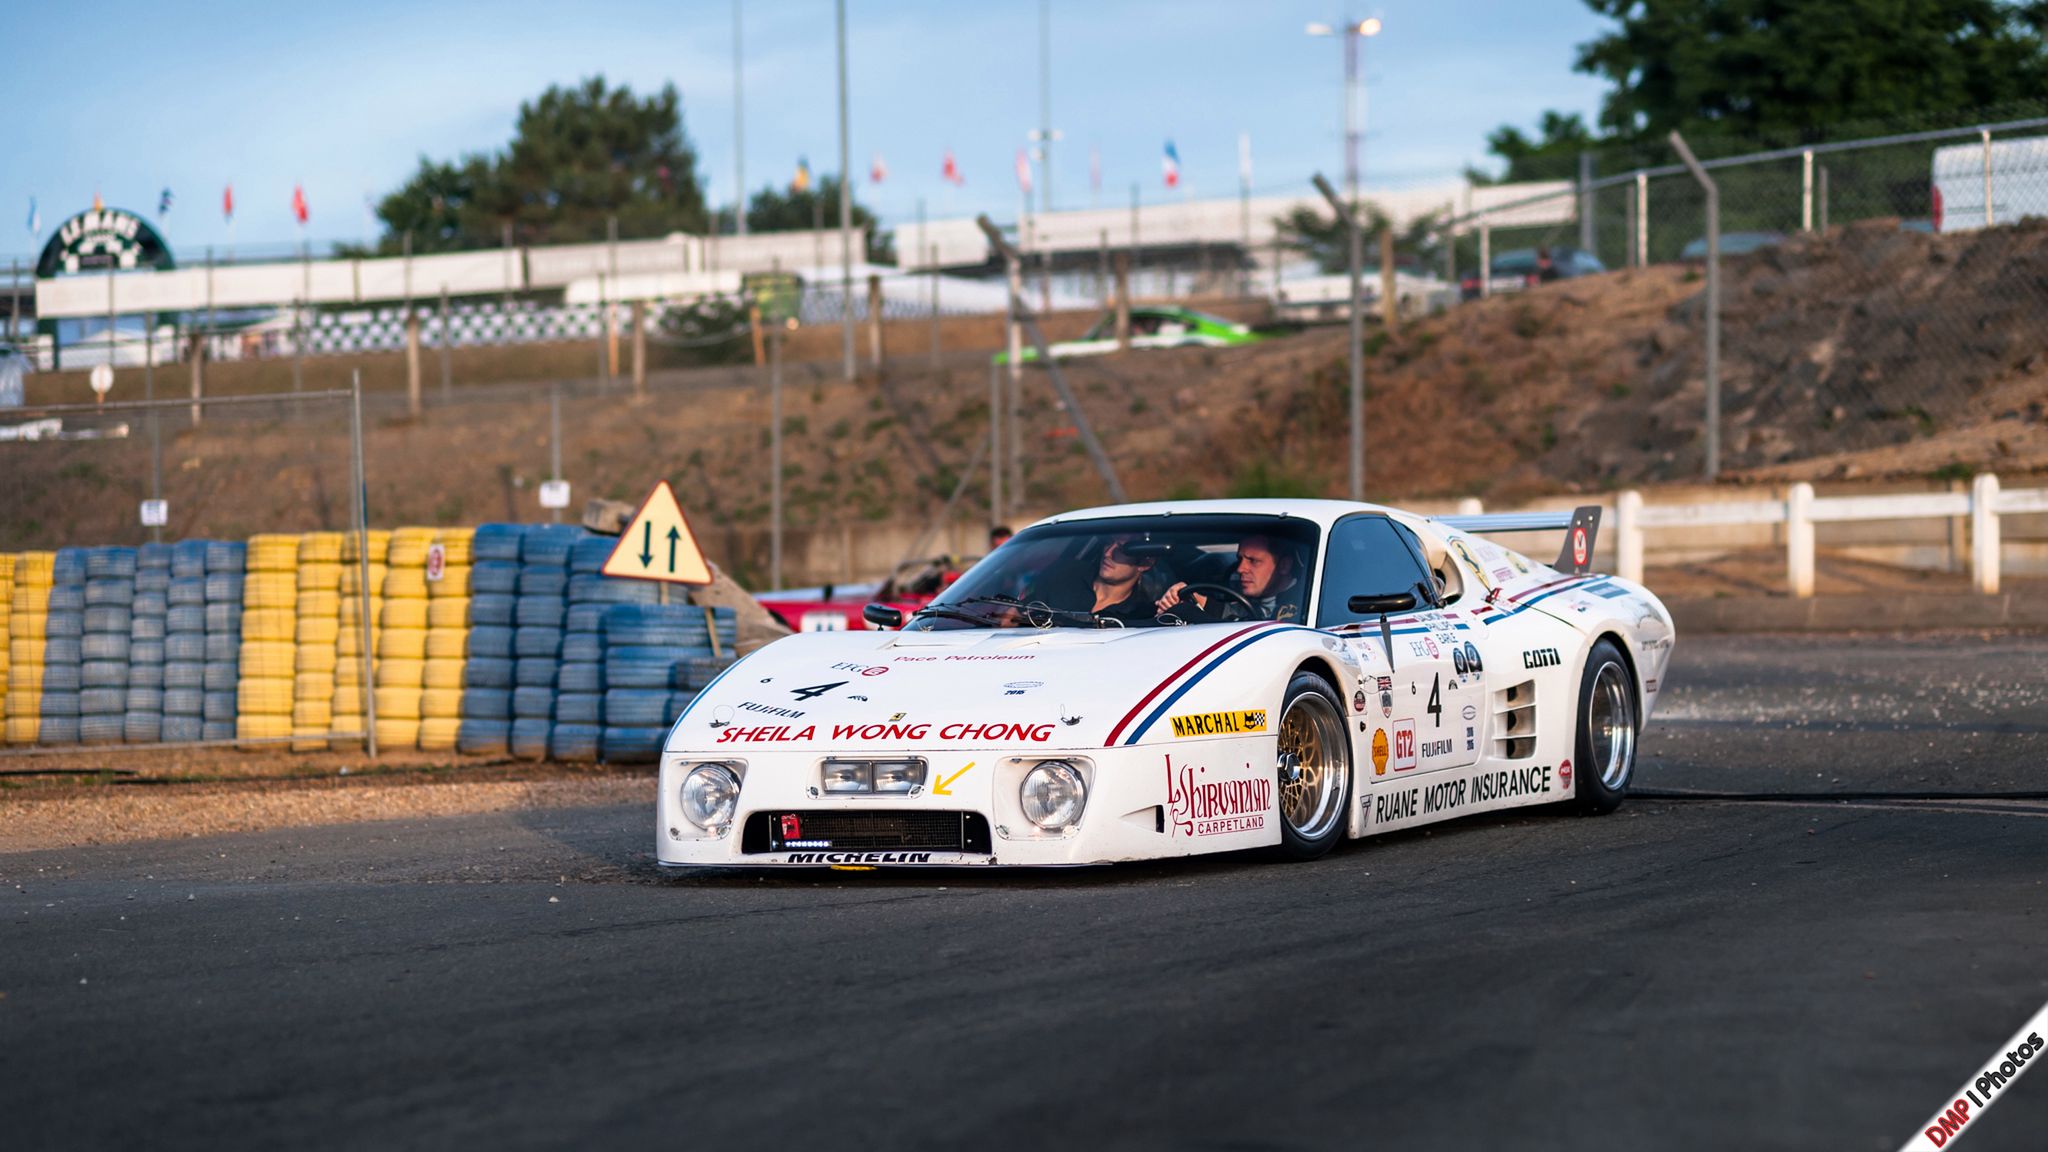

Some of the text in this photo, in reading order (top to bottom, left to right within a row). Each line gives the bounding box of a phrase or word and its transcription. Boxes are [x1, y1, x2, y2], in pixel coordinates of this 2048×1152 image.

[790, 680, 850, 701] 4
[1411, 681, 1417, 695] 6
[1427, 672, 1442, 727] 4
[738, 701, 806, 719] FUJIFILM
[717, 723, 1056, 743] SHEILA WONG CHONG
[1172, 712, 1240, 736] MARCHAL
[1373, 745, 1387, 757] SHELL
[1396, 730, 1414, 759] GT2
[1422, 739, 1453, 758] FUJIFILM
[1375, 766, 1552, 824] RUANE MOTOR INSURANCE
[1198, 816, 1264, 834] CARPETLAND
[788, 853, 932, 863] MICHELIN
